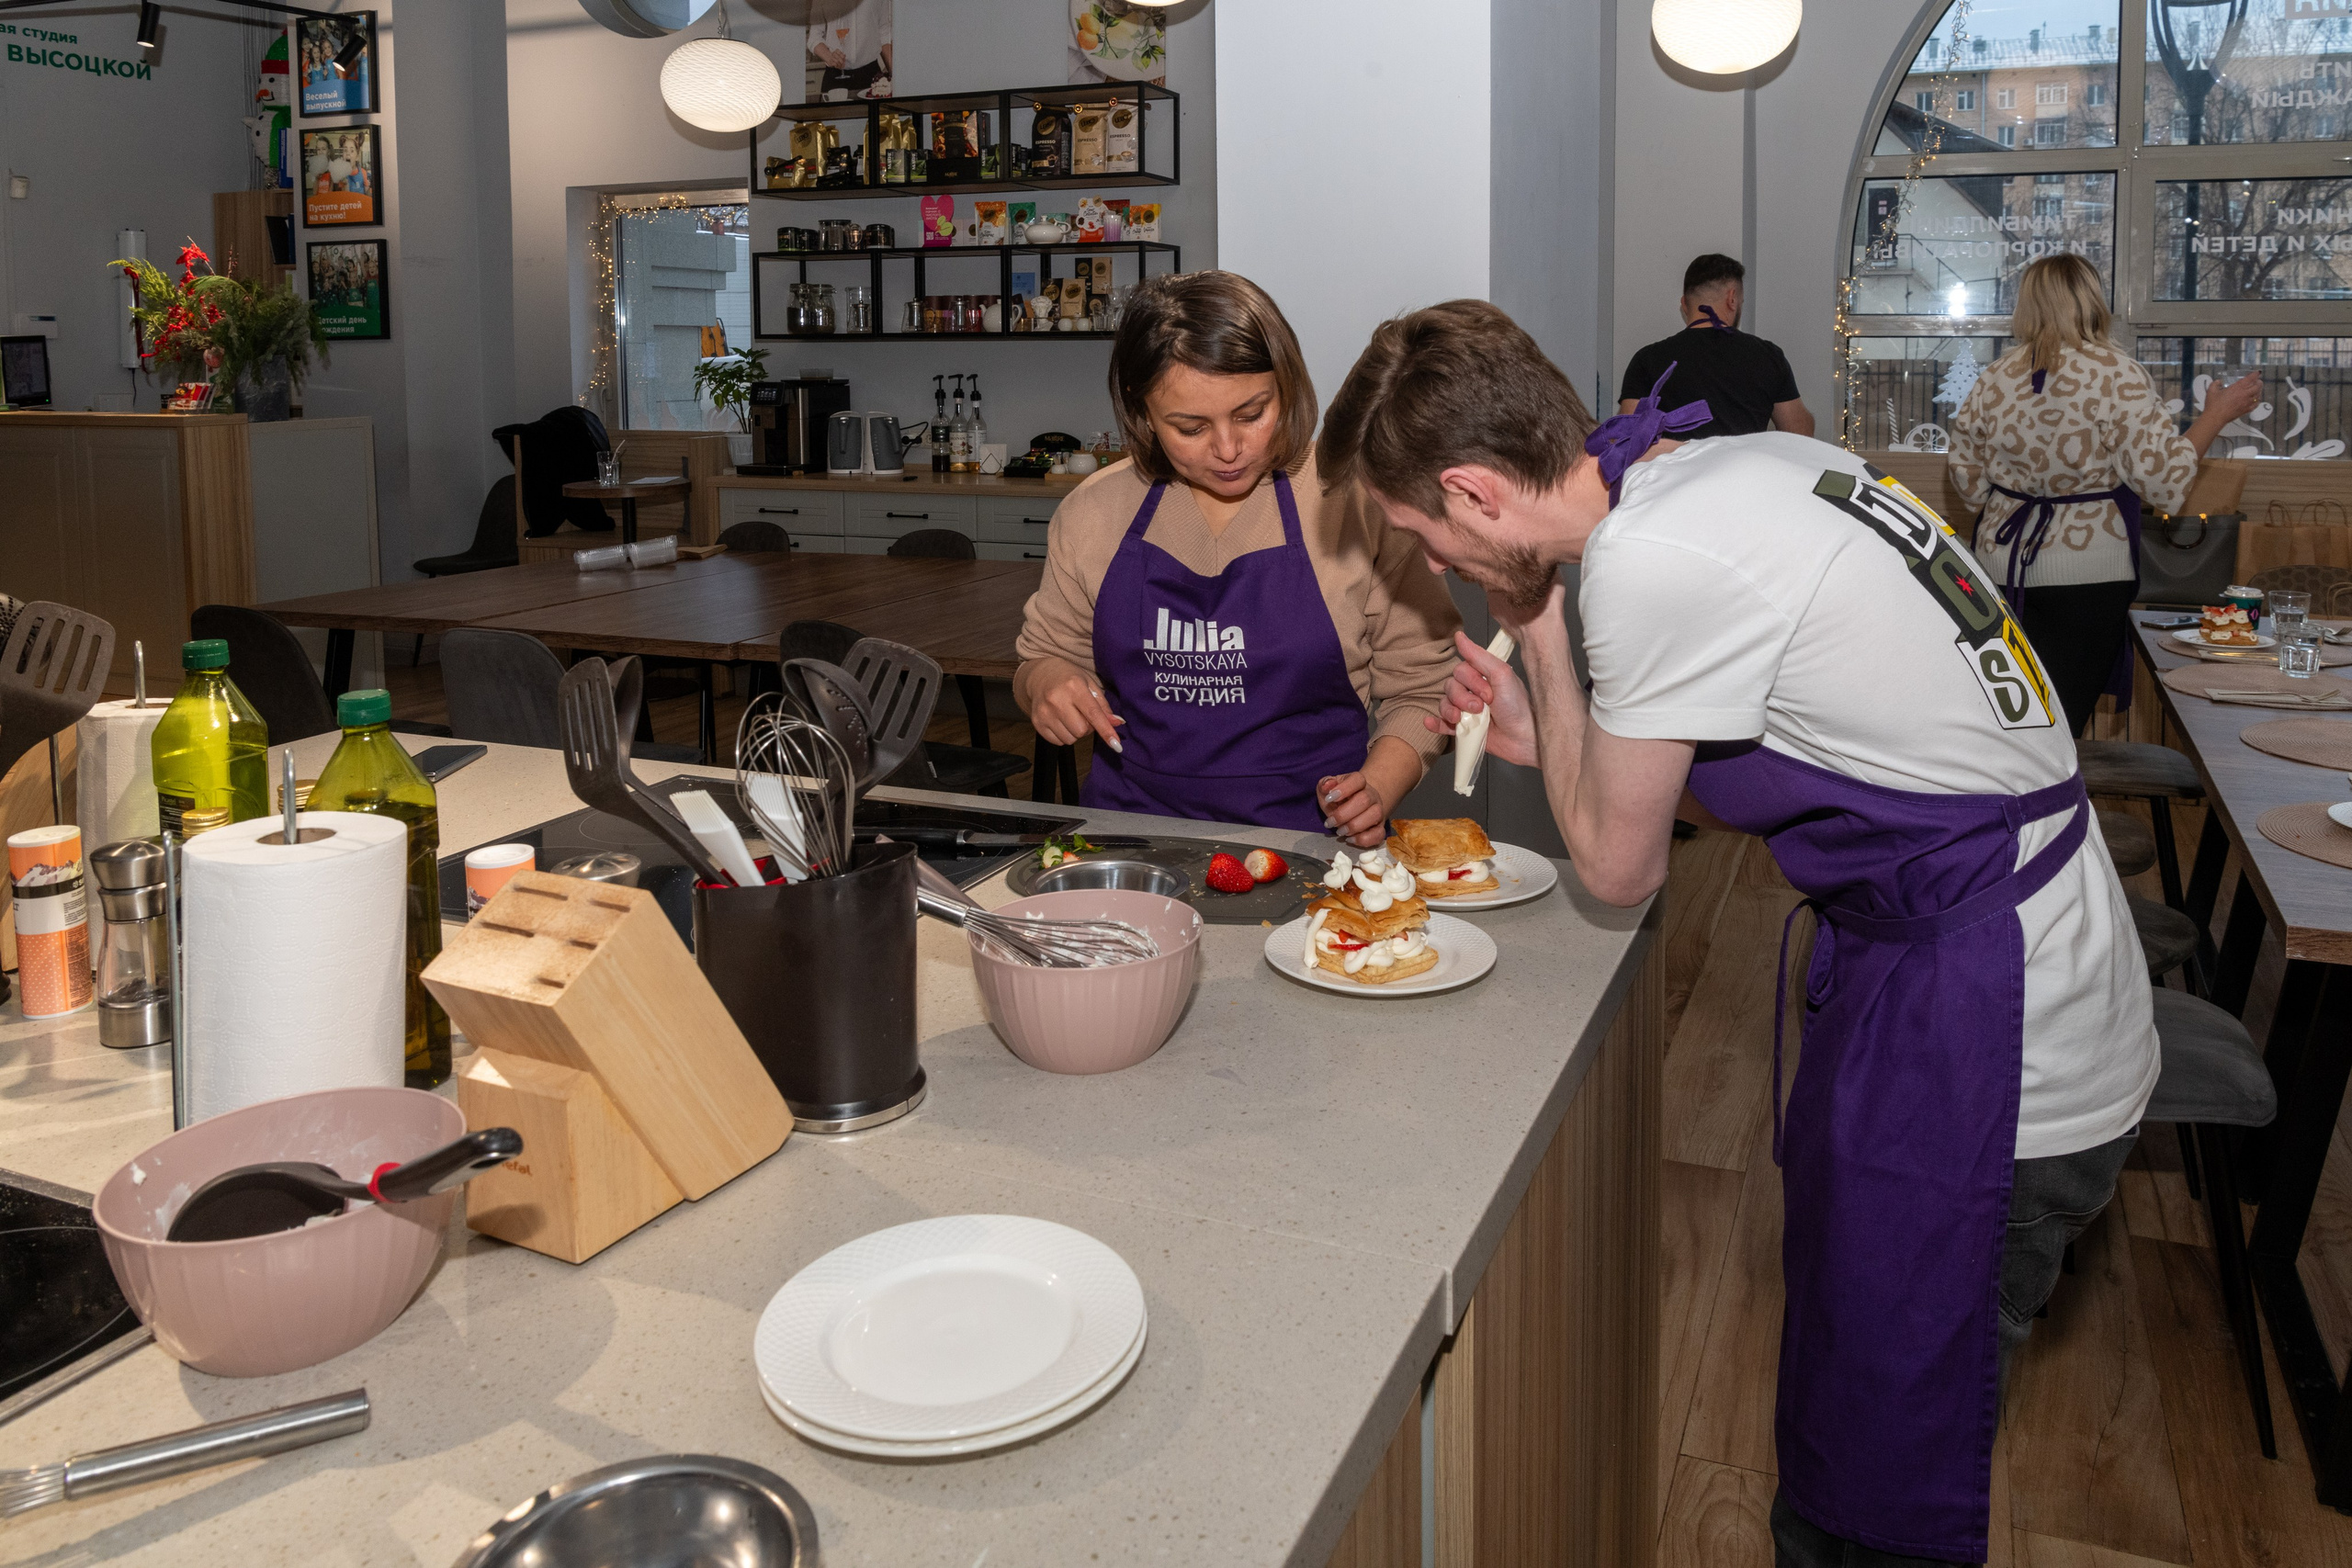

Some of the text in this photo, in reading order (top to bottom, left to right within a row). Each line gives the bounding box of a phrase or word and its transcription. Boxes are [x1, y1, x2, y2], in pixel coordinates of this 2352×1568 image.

[22, 28, 78, 44] студия
[7, 44, 152, 81] ВЫСОЦКОЙ
[305, 90, 338, 101] Веселый
[306, 99, 346, 111] выпускной
[309, 200, 362, 213] Пустите детей
[309, 211, 346, 222] на кухню!
[348, 316, 368, 324] день
[322, 326, 355, 334] ождения
[1143, 607, 1245, 652] Julia
[1144, 651, 1248, 671] VYSOTSKAYA
[1155, 671, 1243, 686] КУЛИНАРНАЯ
[1154, 685, 1246, 706] СТУДИЯ
